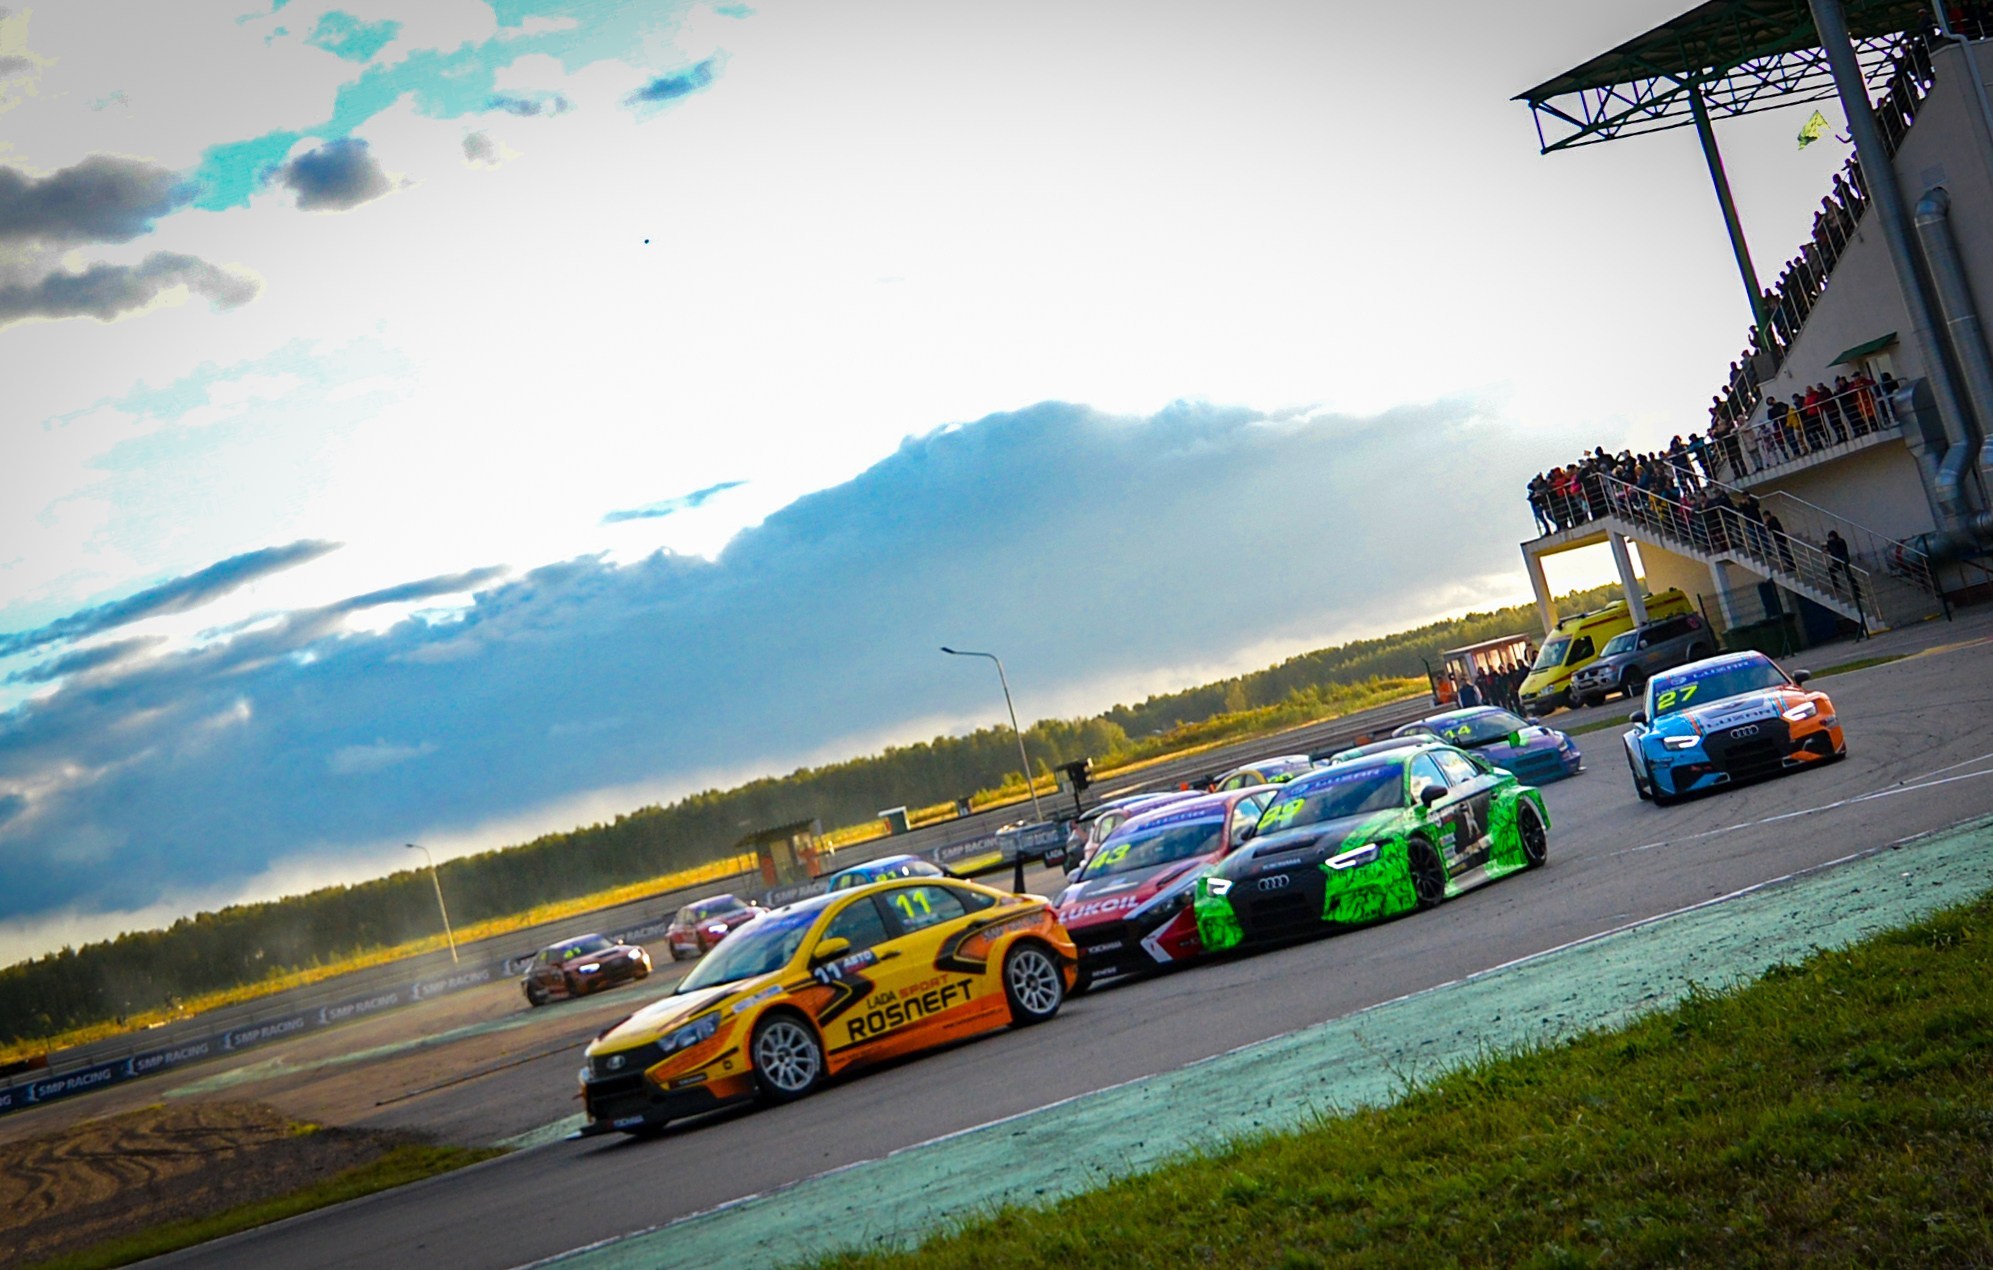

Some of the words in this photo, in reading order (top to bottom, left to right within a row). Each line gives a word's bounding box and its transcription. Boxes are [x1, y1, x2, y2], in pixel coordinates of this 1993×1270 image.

[1657, 684, 1698, 711] 27
[1706, 708, 1771, 729] LUXAR
[1257, 798, 1305, 830] 89
[1087, 843, 1131, 870] 43
[896, 891, 931, 918] 11
[1058, 895, 1139, 923] LUKOIL
[422, 980, 447, 996] SMP
[448, 969, 490, 990] RACING
[814, 963, 842, 983] 11
[866, 991, 897, 1009] LADA
[899, 974, 949, 999] SPORT
[329, 1004, 355, 1020] SMP
[356, 992, 398, 1014] RACING
[846, 978, 973, 1041] ROSNEFT
[234, 1029, 260, 1045] SMP
[261, 1017, 304, 1039] RACING
[138, 1055, 163, 1071] SMP
[164, 1042, 209, 1063] RACING
[38, 1081, 65, 1097] SMP
[67, 1068, 112, 1090] RACING
